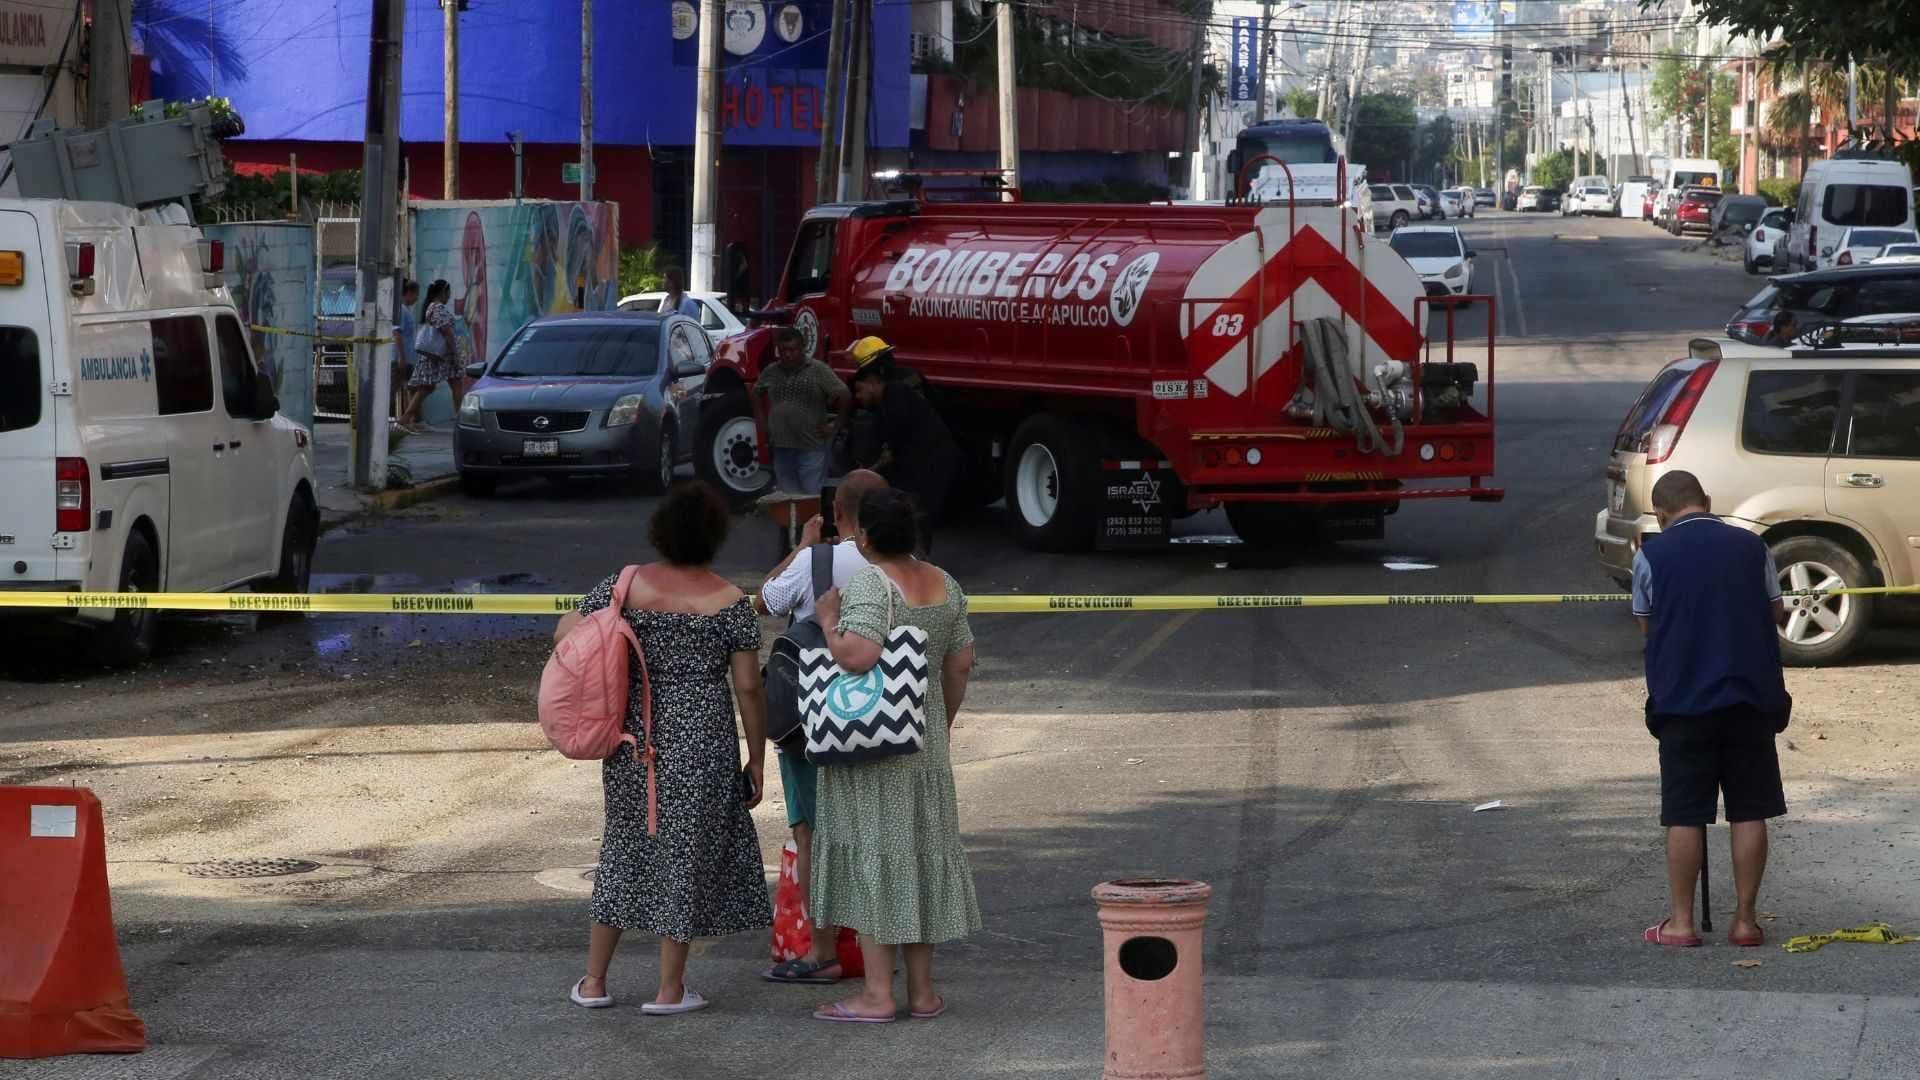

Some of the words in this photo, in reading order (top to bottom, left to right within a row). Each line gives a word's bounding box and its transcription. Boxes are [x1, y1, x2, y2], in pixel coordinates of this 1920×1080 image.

[720, 83, 826, 130] HOTEL
[884, 248, 1119, 300] BOMBEROS
[909, 296, 1009, 321] AYUNTAMIENTO
[1212, 313, 1244, 337] 83
[81, 357, 138, 380] AMBULANCIA
[1107, 485, 1151, 496] ISRAEL
